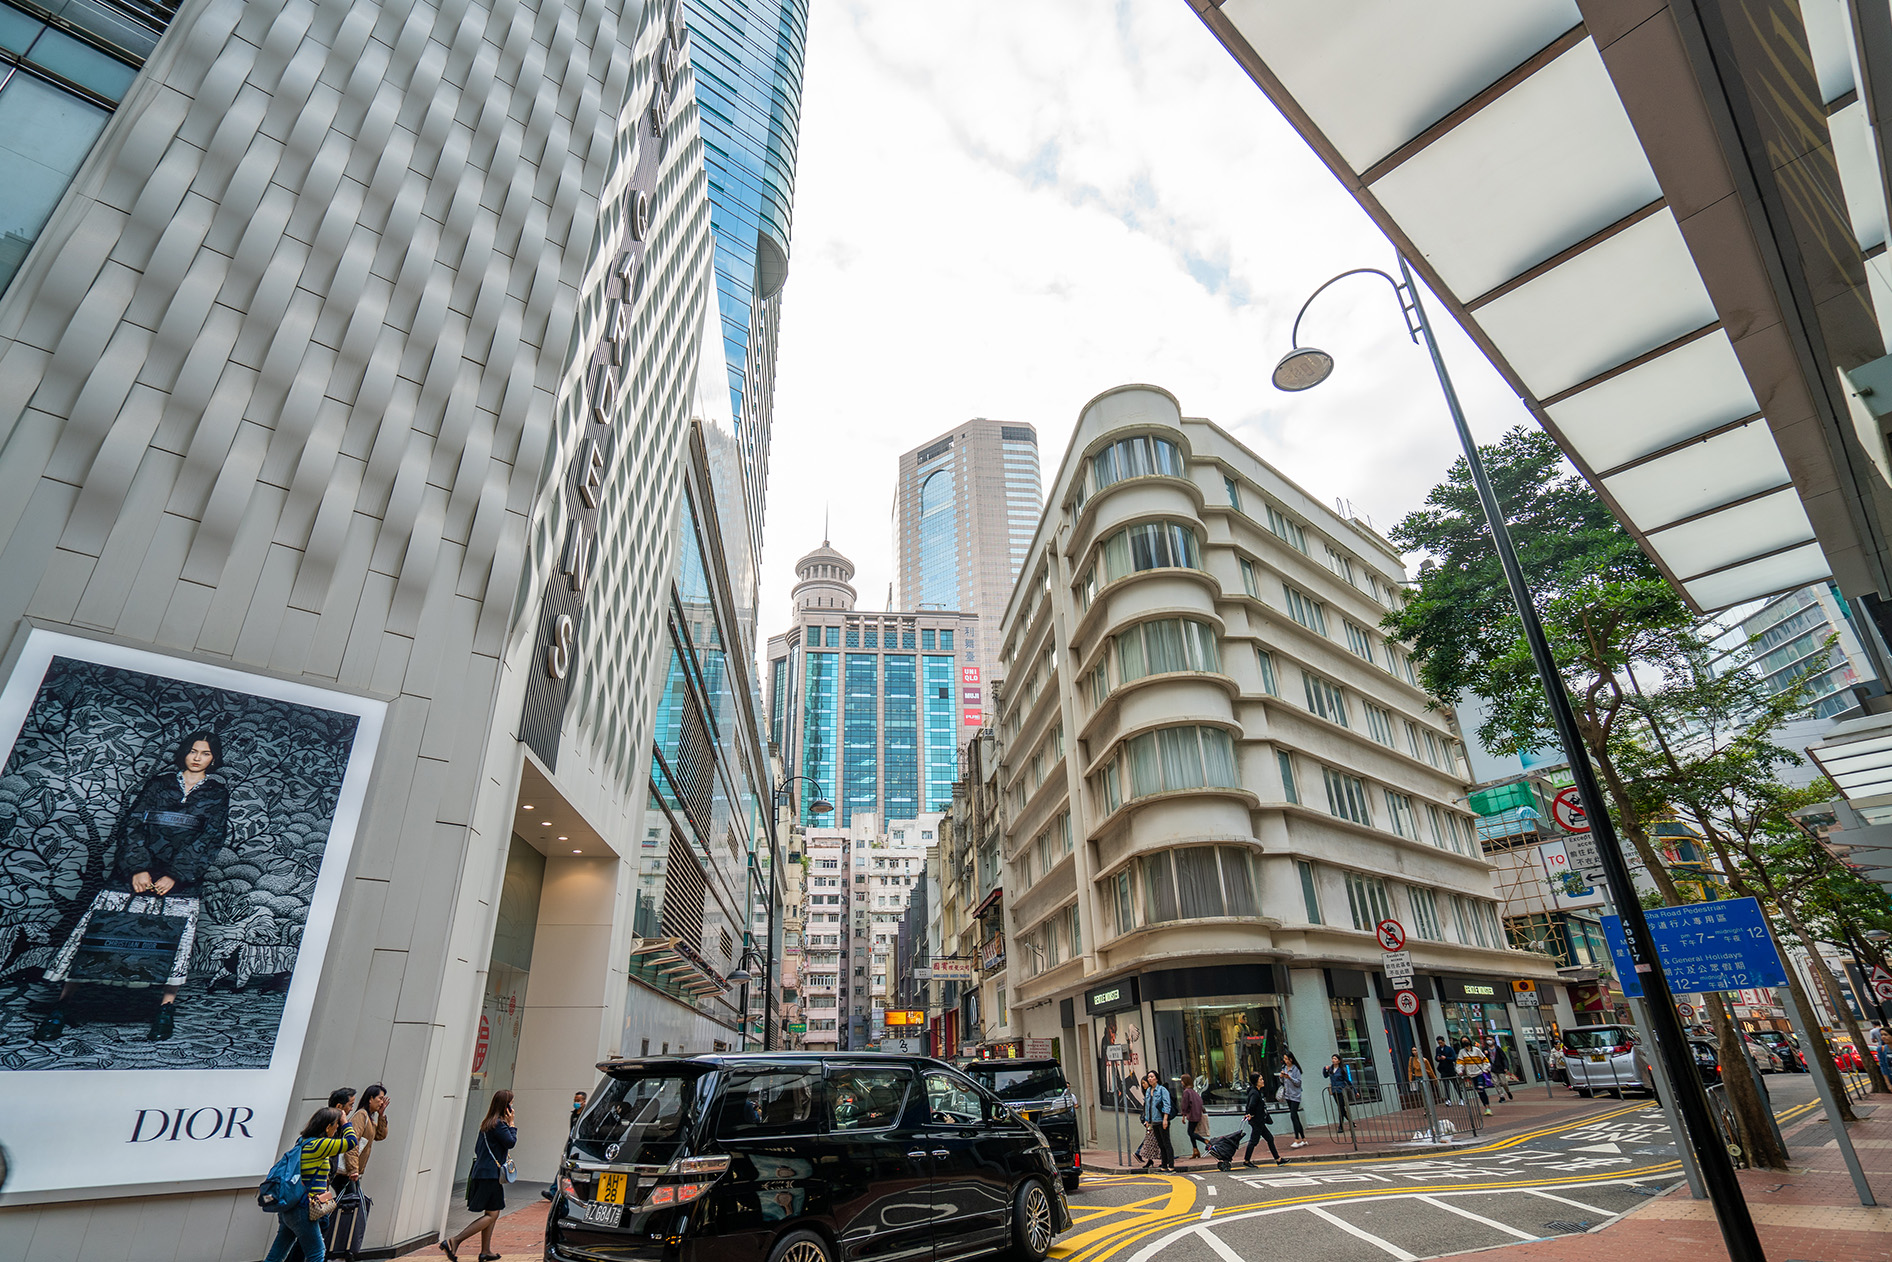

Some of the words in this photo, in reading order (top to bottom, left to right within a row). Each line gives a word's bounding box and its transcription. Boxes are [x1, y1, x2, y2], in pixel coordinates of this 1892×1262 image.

[548, 189, 649, 681] GARDENS
[1552, 770, 1574, 784] PO
[1569, 834, 1592, 843] Except
[1570, 847, 1598, 858] 前往此
[1576, 856, 1602, 866] 不在此
[1644, 912, 1660, 920] Sha
[1660, 910, 1682, 918] Road
[1682, 904, 1727, 915] Pedestrian
[1647, 913, 1727, 931] 沙道行人專用區
[1622, 919, 1641, 962] 49317
[1695, 932, 1704, 944] 7
[1714, 927, 1744, 935] midnight
[1746, 926, 1765, 939] 12
[1679, 939, 1697, 947] 下午
[1671, 955, 1704, 964] General
[1705, 952, 1743, 961] Holidays
[1663, 961, 1746, 977] 期六及公眾假期
[1674, 978, 1692, 990] 12
[1731, 973, 1749, 986] 12
[124, 1106, 254, 1144] DIOR
[1574, 1122, 1673, 1134] ACCE
[606, 1174, 619, 1189] AH
[604, 1188, 618, 1202] 28
